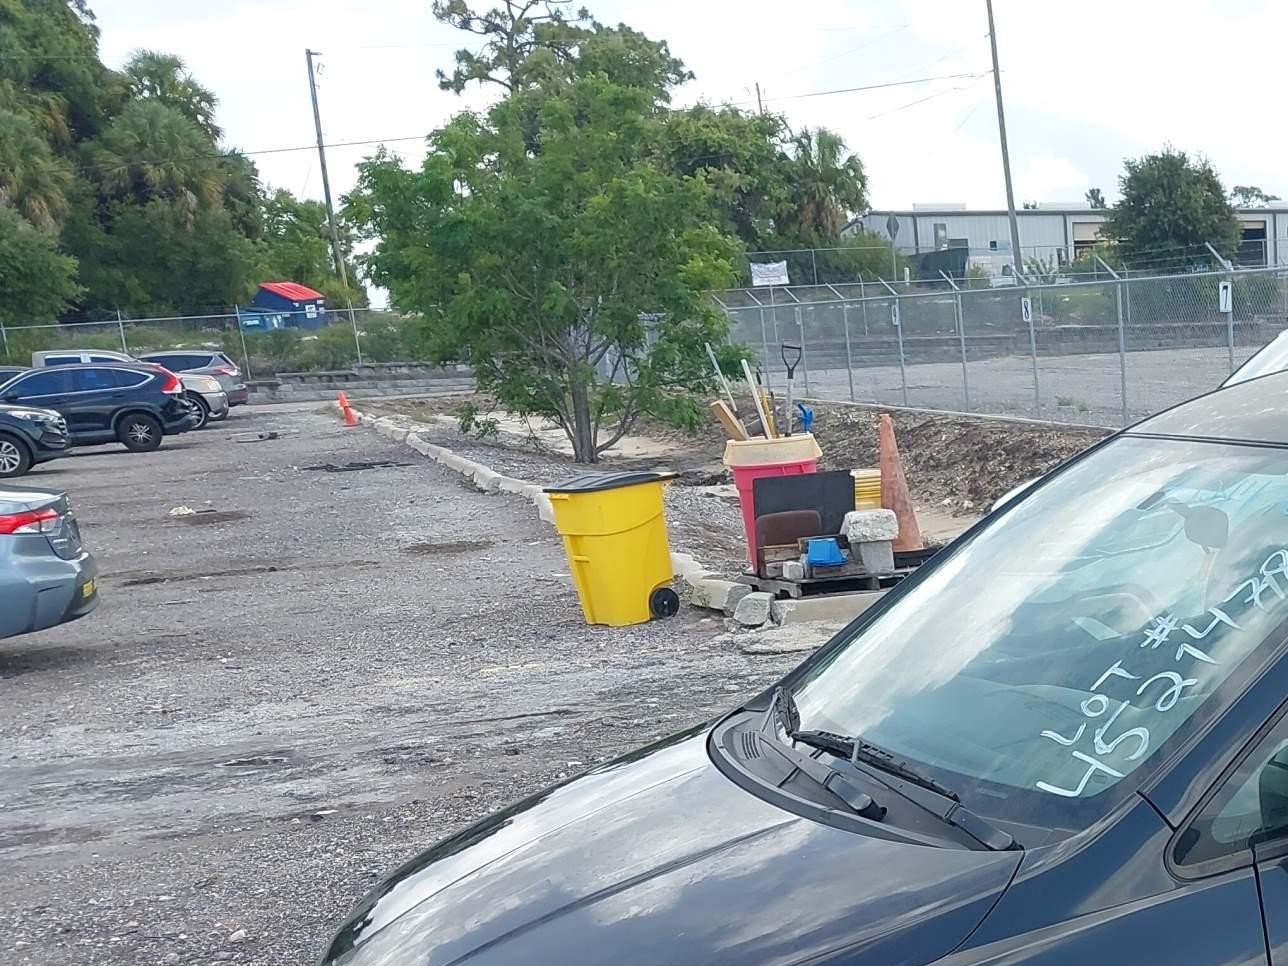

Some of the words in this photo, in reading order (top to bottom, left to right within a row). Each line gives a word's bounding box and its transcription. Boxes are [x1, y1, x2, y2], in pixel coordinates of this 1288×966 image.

[1222, 285, 1229, 309] 7
[1023, 300, 1030, 320] 8
[1041, 659, 1142, 746] LOT
[1139, 612, 1181, 649] #
